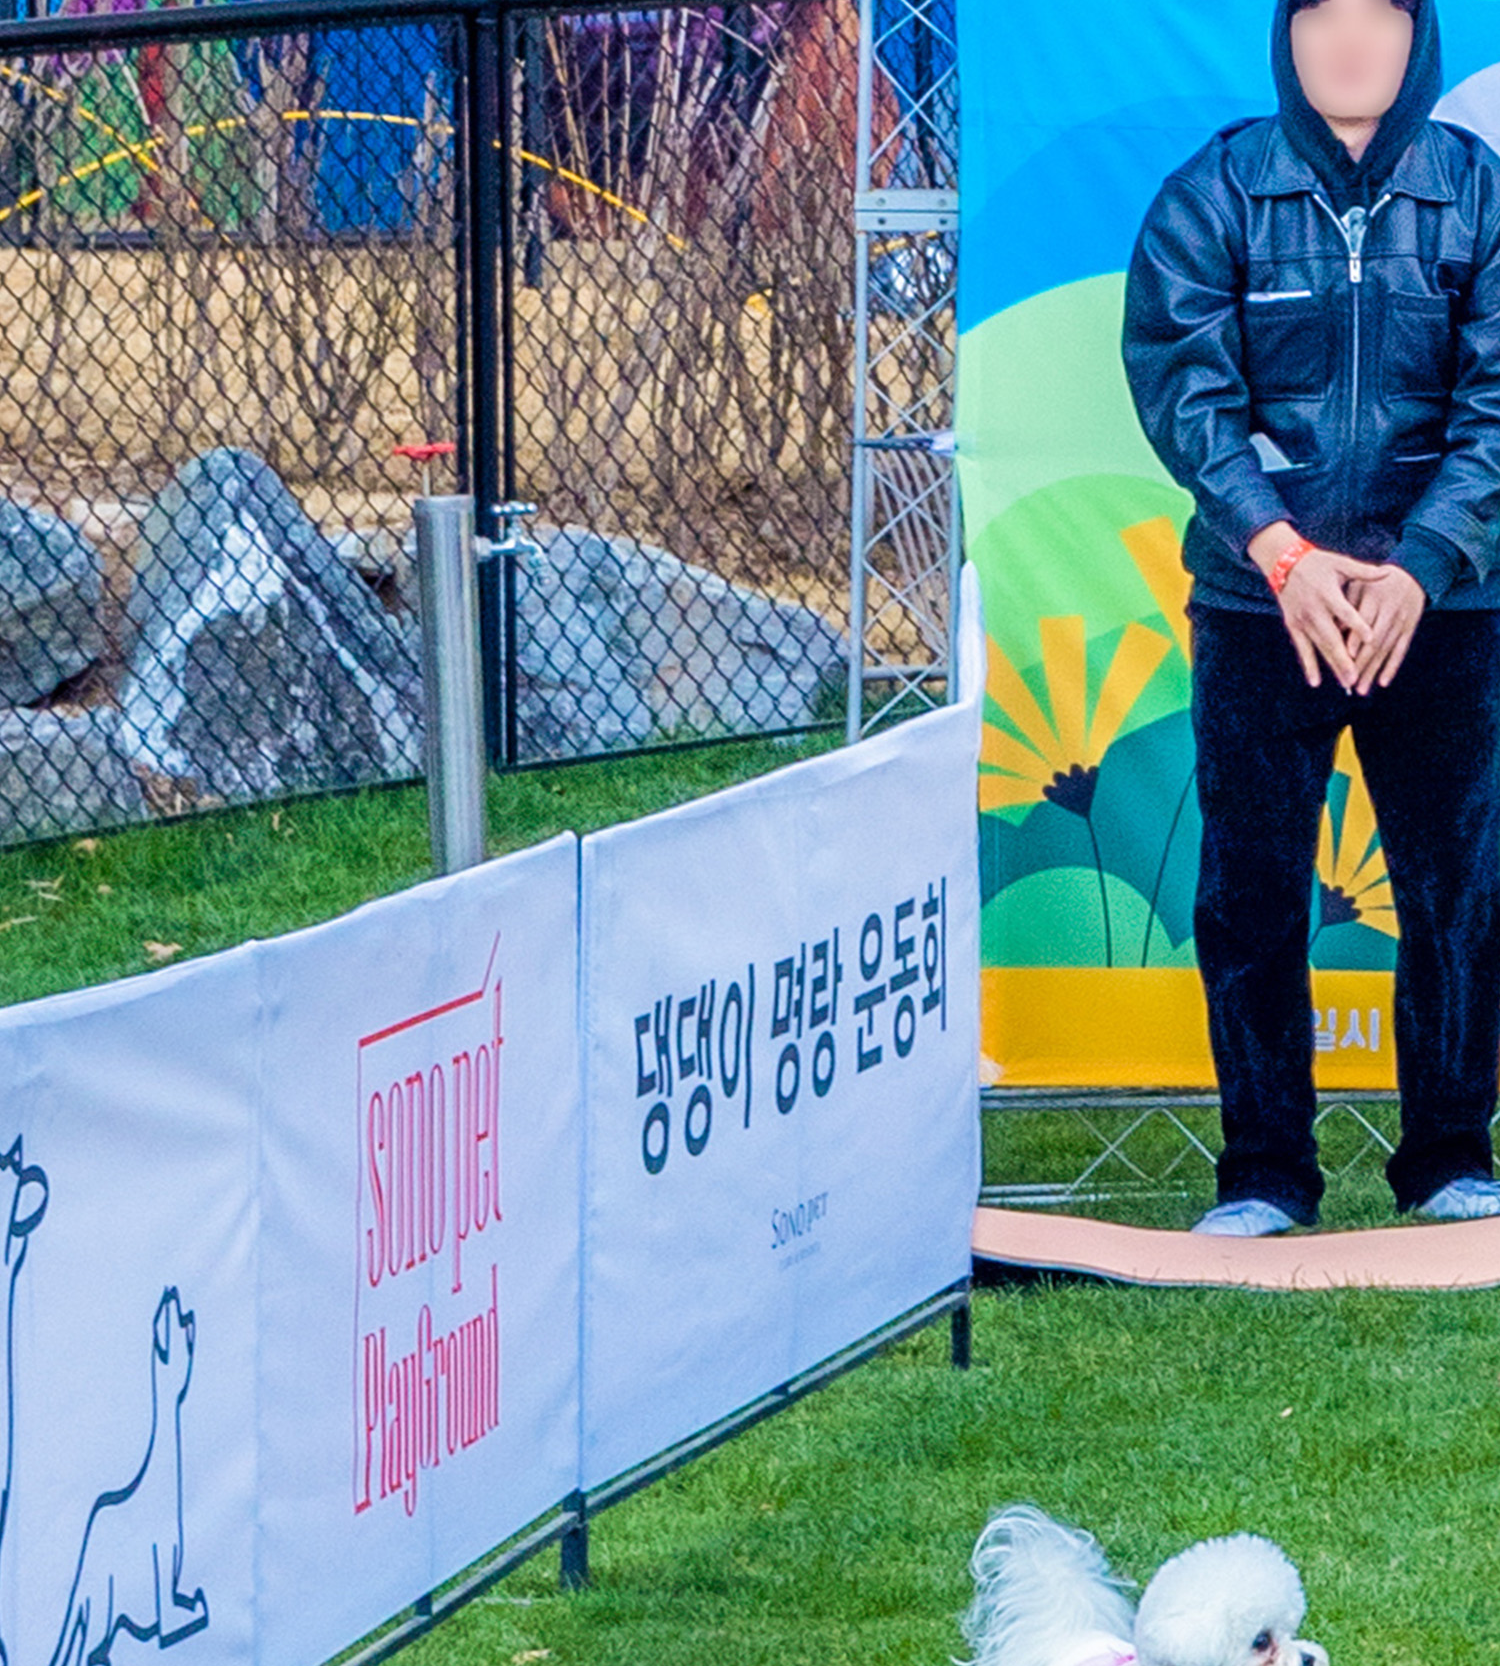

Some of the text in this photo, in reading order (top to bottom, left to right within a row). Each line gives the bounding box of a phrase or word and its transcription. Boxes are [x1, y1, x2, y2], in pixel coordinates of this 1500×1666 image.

[634, 876, 947, 1175] 댕댕이 명랑 운동회
